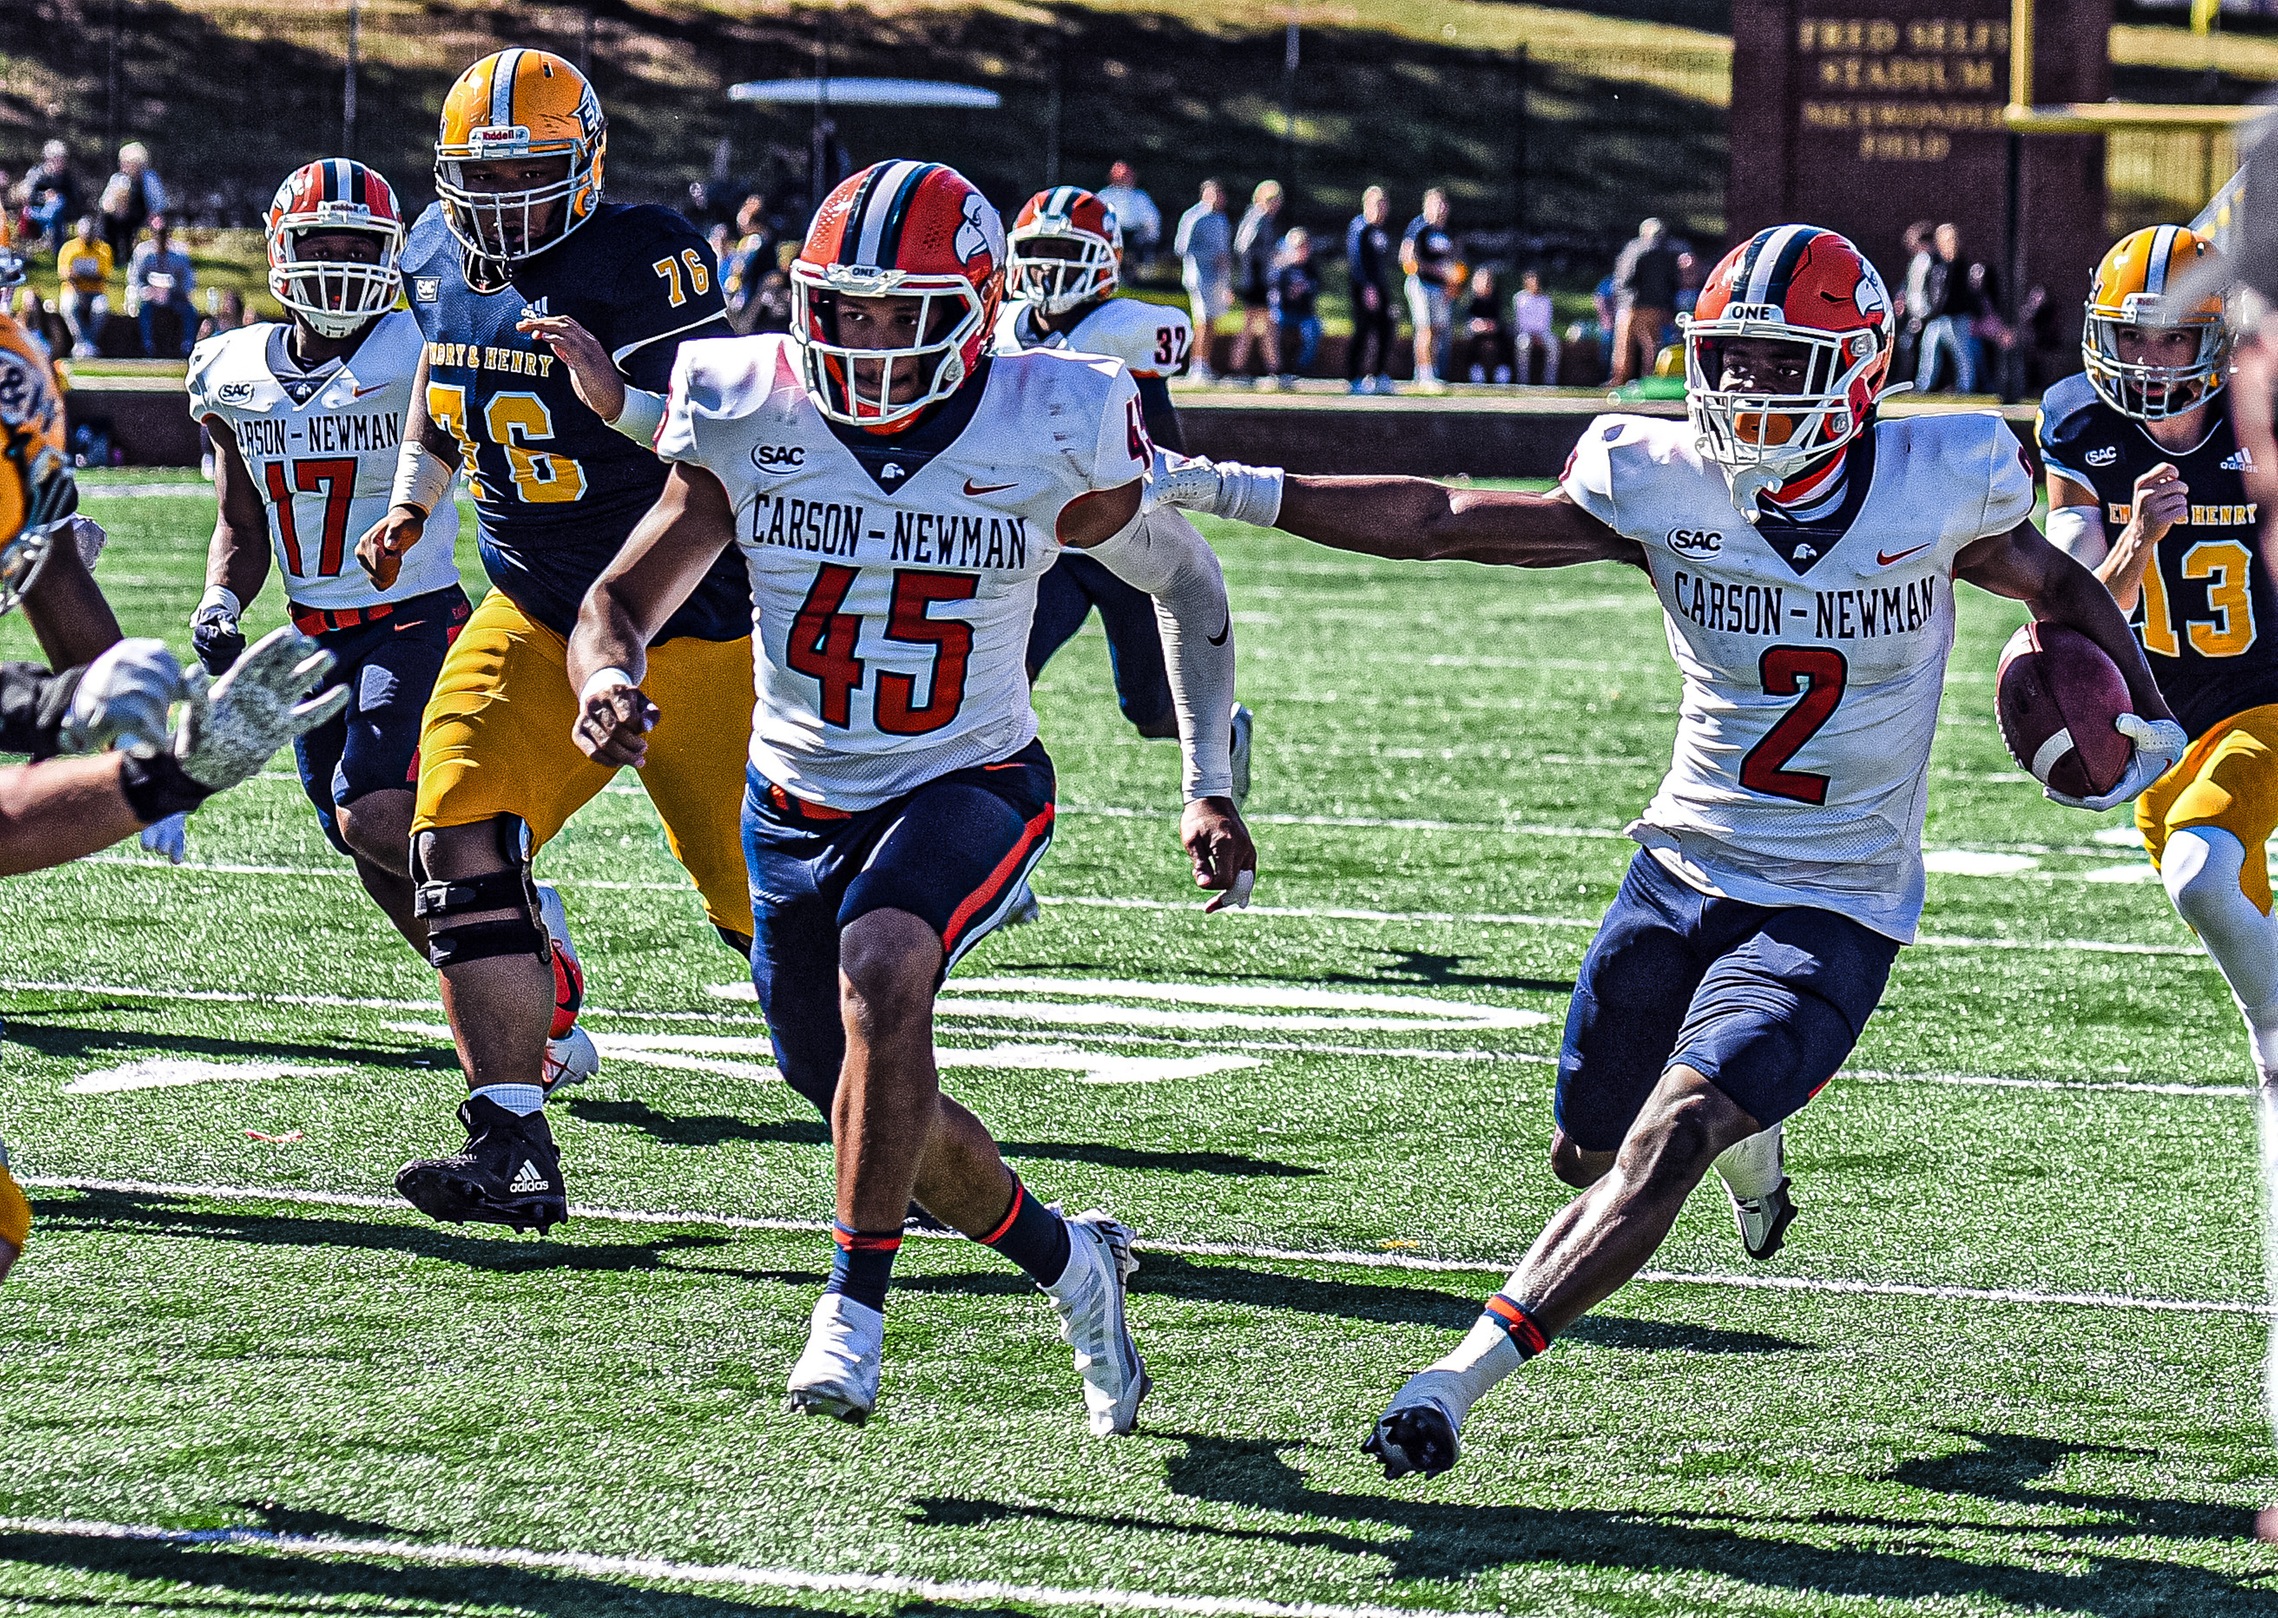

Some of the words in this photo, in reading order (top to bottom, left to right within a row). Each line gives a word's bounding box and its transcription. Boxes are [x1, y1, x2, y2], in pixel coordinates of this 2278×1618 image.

[652, 248, 709, 308] 76
[852, 267, 875, 278] ONE
[1732, 305, 1770, 321] ONE
[1154, 326, 1187, 366] 32
[467, 344, 480, 369] &
[483, 346, 554, 378] HENRY
[221, 383, 252, 400] SAC
[426, 379, 588, 503] 76
[2087, 446, 2118, 463] SAC
[758, 445, 806, 467] SAC
[264, 456, 358, 578] 17
[2190, 503, 2258, 526] HENRY
[1674, 529, 1723, 552] SAC
[2130, 539, 2258, 658] 13
[785, 561, 982, 737] 45
[1738, 644, 1849, 807] 2
[510, 1180, 549, 1193] adidas
